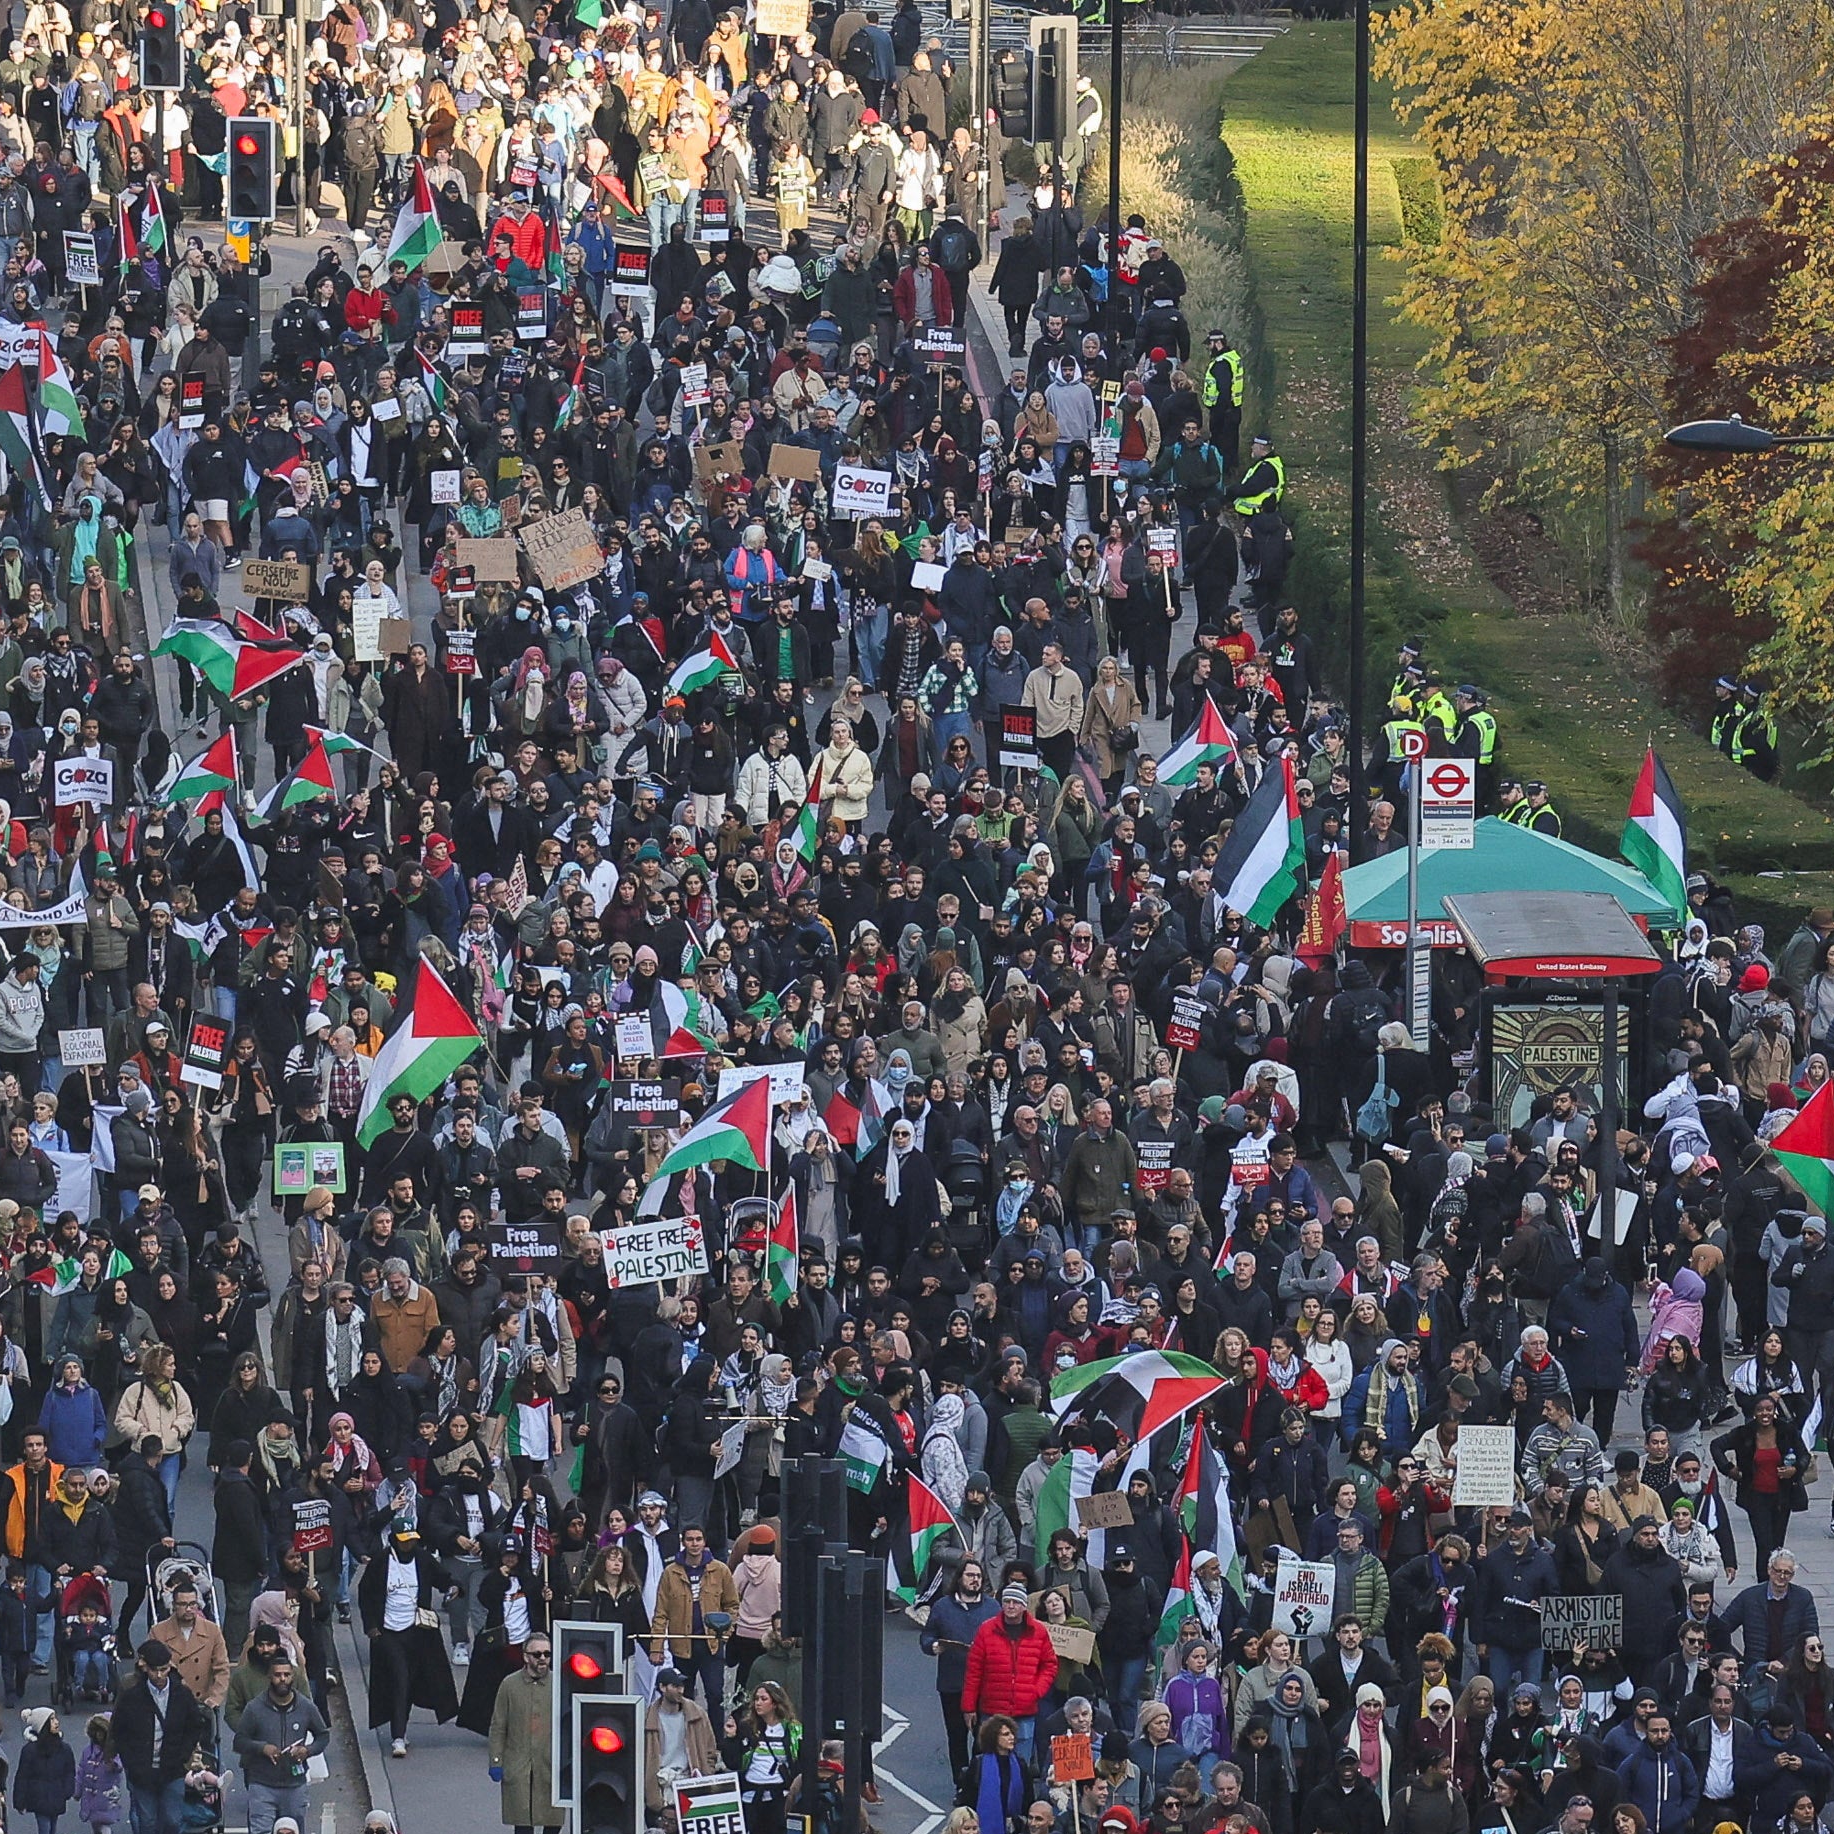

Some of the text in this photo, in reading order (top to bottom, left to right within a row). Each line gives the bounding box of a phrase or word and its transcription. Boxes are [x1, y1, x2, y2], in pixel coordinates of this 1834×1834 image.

[618, 251, 647, 269] FREE
[453, 310, 483, 326] FREE
[928, 328, 952, 341] Free
[915, 339, 965, 352] Palestine
[247, 564, 299, 582] CEASEFIRE
[264, 576, 291, 588] NOW
[1004, 714, 1033, 733] FREE
[1406, 734, 1423, 755] D
[65, 898, 85, 914] UK
[1311, 894, 1324, 946] Socialist
[1536, 963, 1605, 973] United States Embassy
[10, 996, 40, 1012] POLO
[69, 1031, 93, 1042] STOP
[193, 1023, 226, 1049] FREE
[64, 1041, 103, 1052] COLONIAL
[190, 1043, 223, 1063] PALESTINE
[1523, 1047, 1598, 1062] PALESTINE
[63, 1050, 106, 1062] EXPANSION
[630, 1084, 663, 1100] Free
[614, 1097, 679, 1115] Palestine
[1138, 1159, 1171, 1169] PALESTINE
[507, 1228, 539, 1242] Free
[615, 1228, 689, 1256] FREE FREE
[491, 1242, 559, 1260] Palestine
[613, 1250, 706, 1283] PALESTINE
[1461, 1429, 1483, 1438] STOP
[297, 1507, 329, 1521] FREEDOM
[295, 1518, 331, 1531] PALESTINE
[1296, 1570, 1315, 1582] END
[1287, 1581, 1323, 1594] ISRAELI
[1278, 1593, 1328, 1606] APARTHEID
[1543, 1596, 1622, 1622] ARMISTICE
[1542, 1624, 1622, 1651] CEASEFIRE
